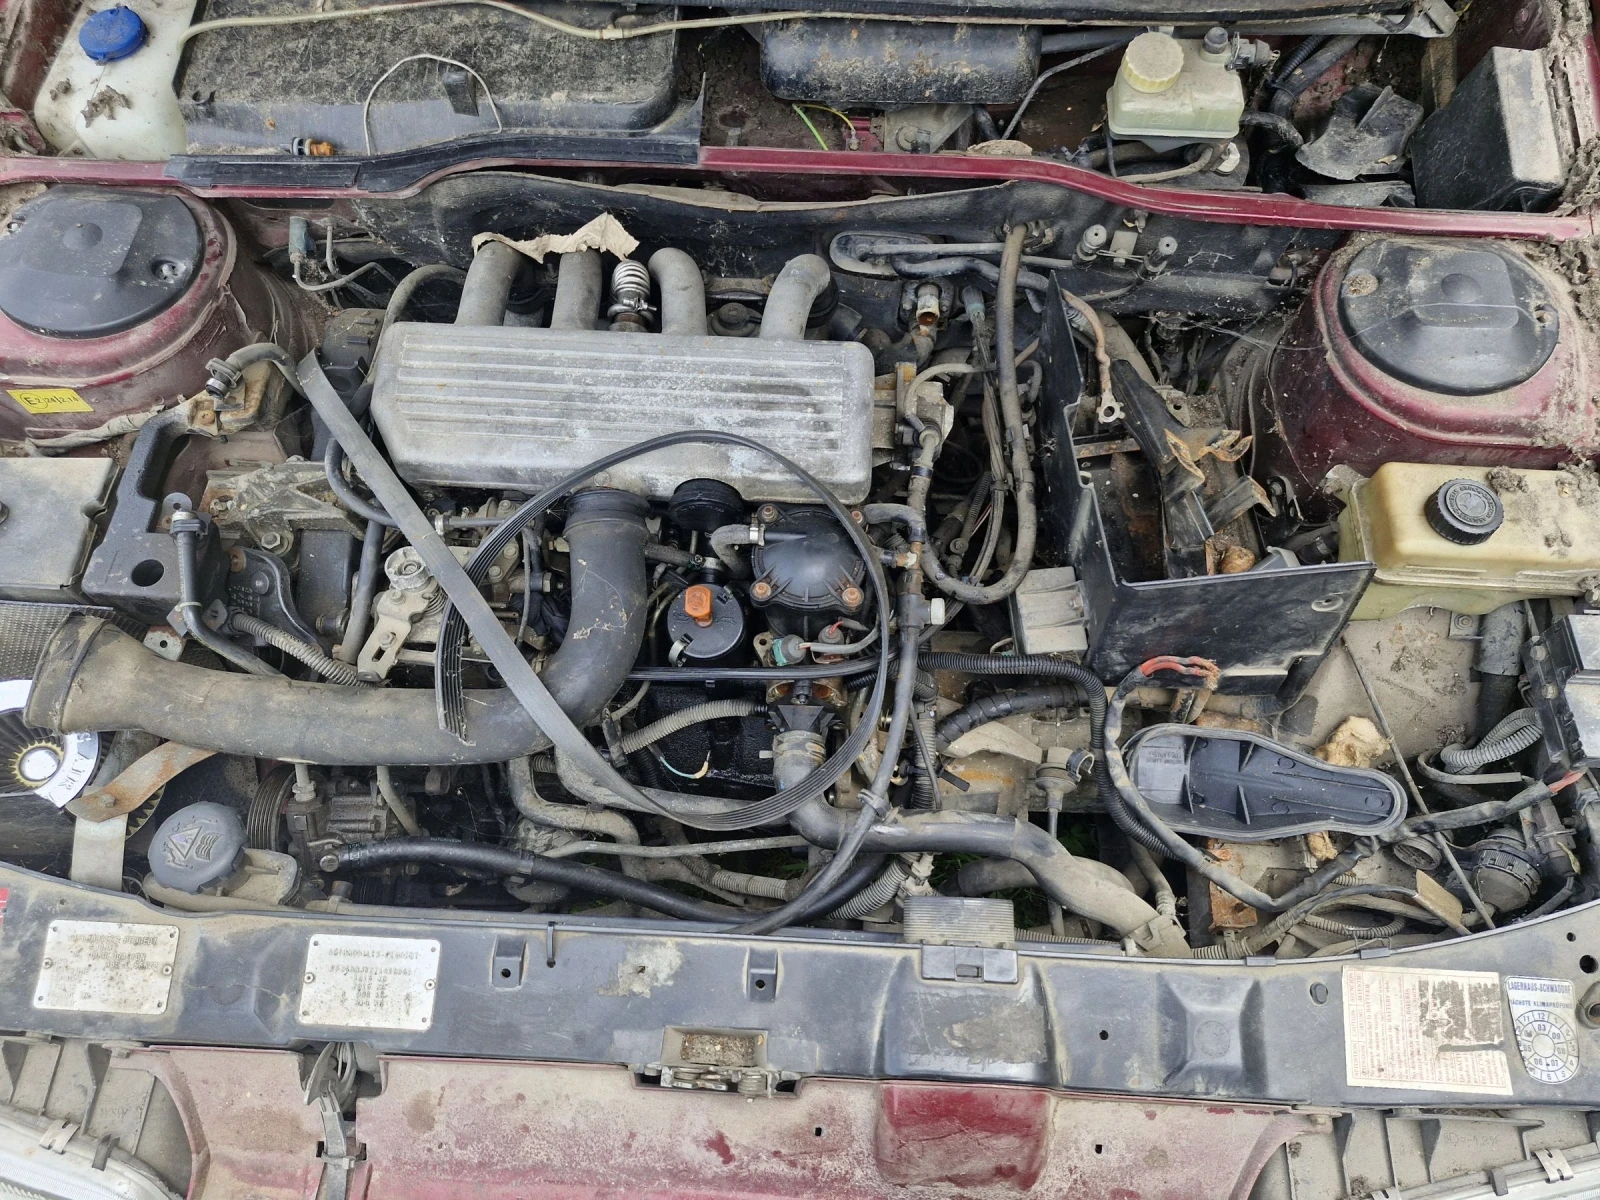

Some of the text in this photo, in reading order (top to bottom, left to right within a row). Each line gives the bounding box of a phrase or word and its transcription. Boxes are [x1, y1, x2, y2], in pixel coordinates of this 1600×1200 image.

[1508, 981, 1571, 994] LAGERHAUS-SCHWADORF
[1538, 1012, 1545, 1020] 12
[1552, 1032, 1561, 1040] 09
